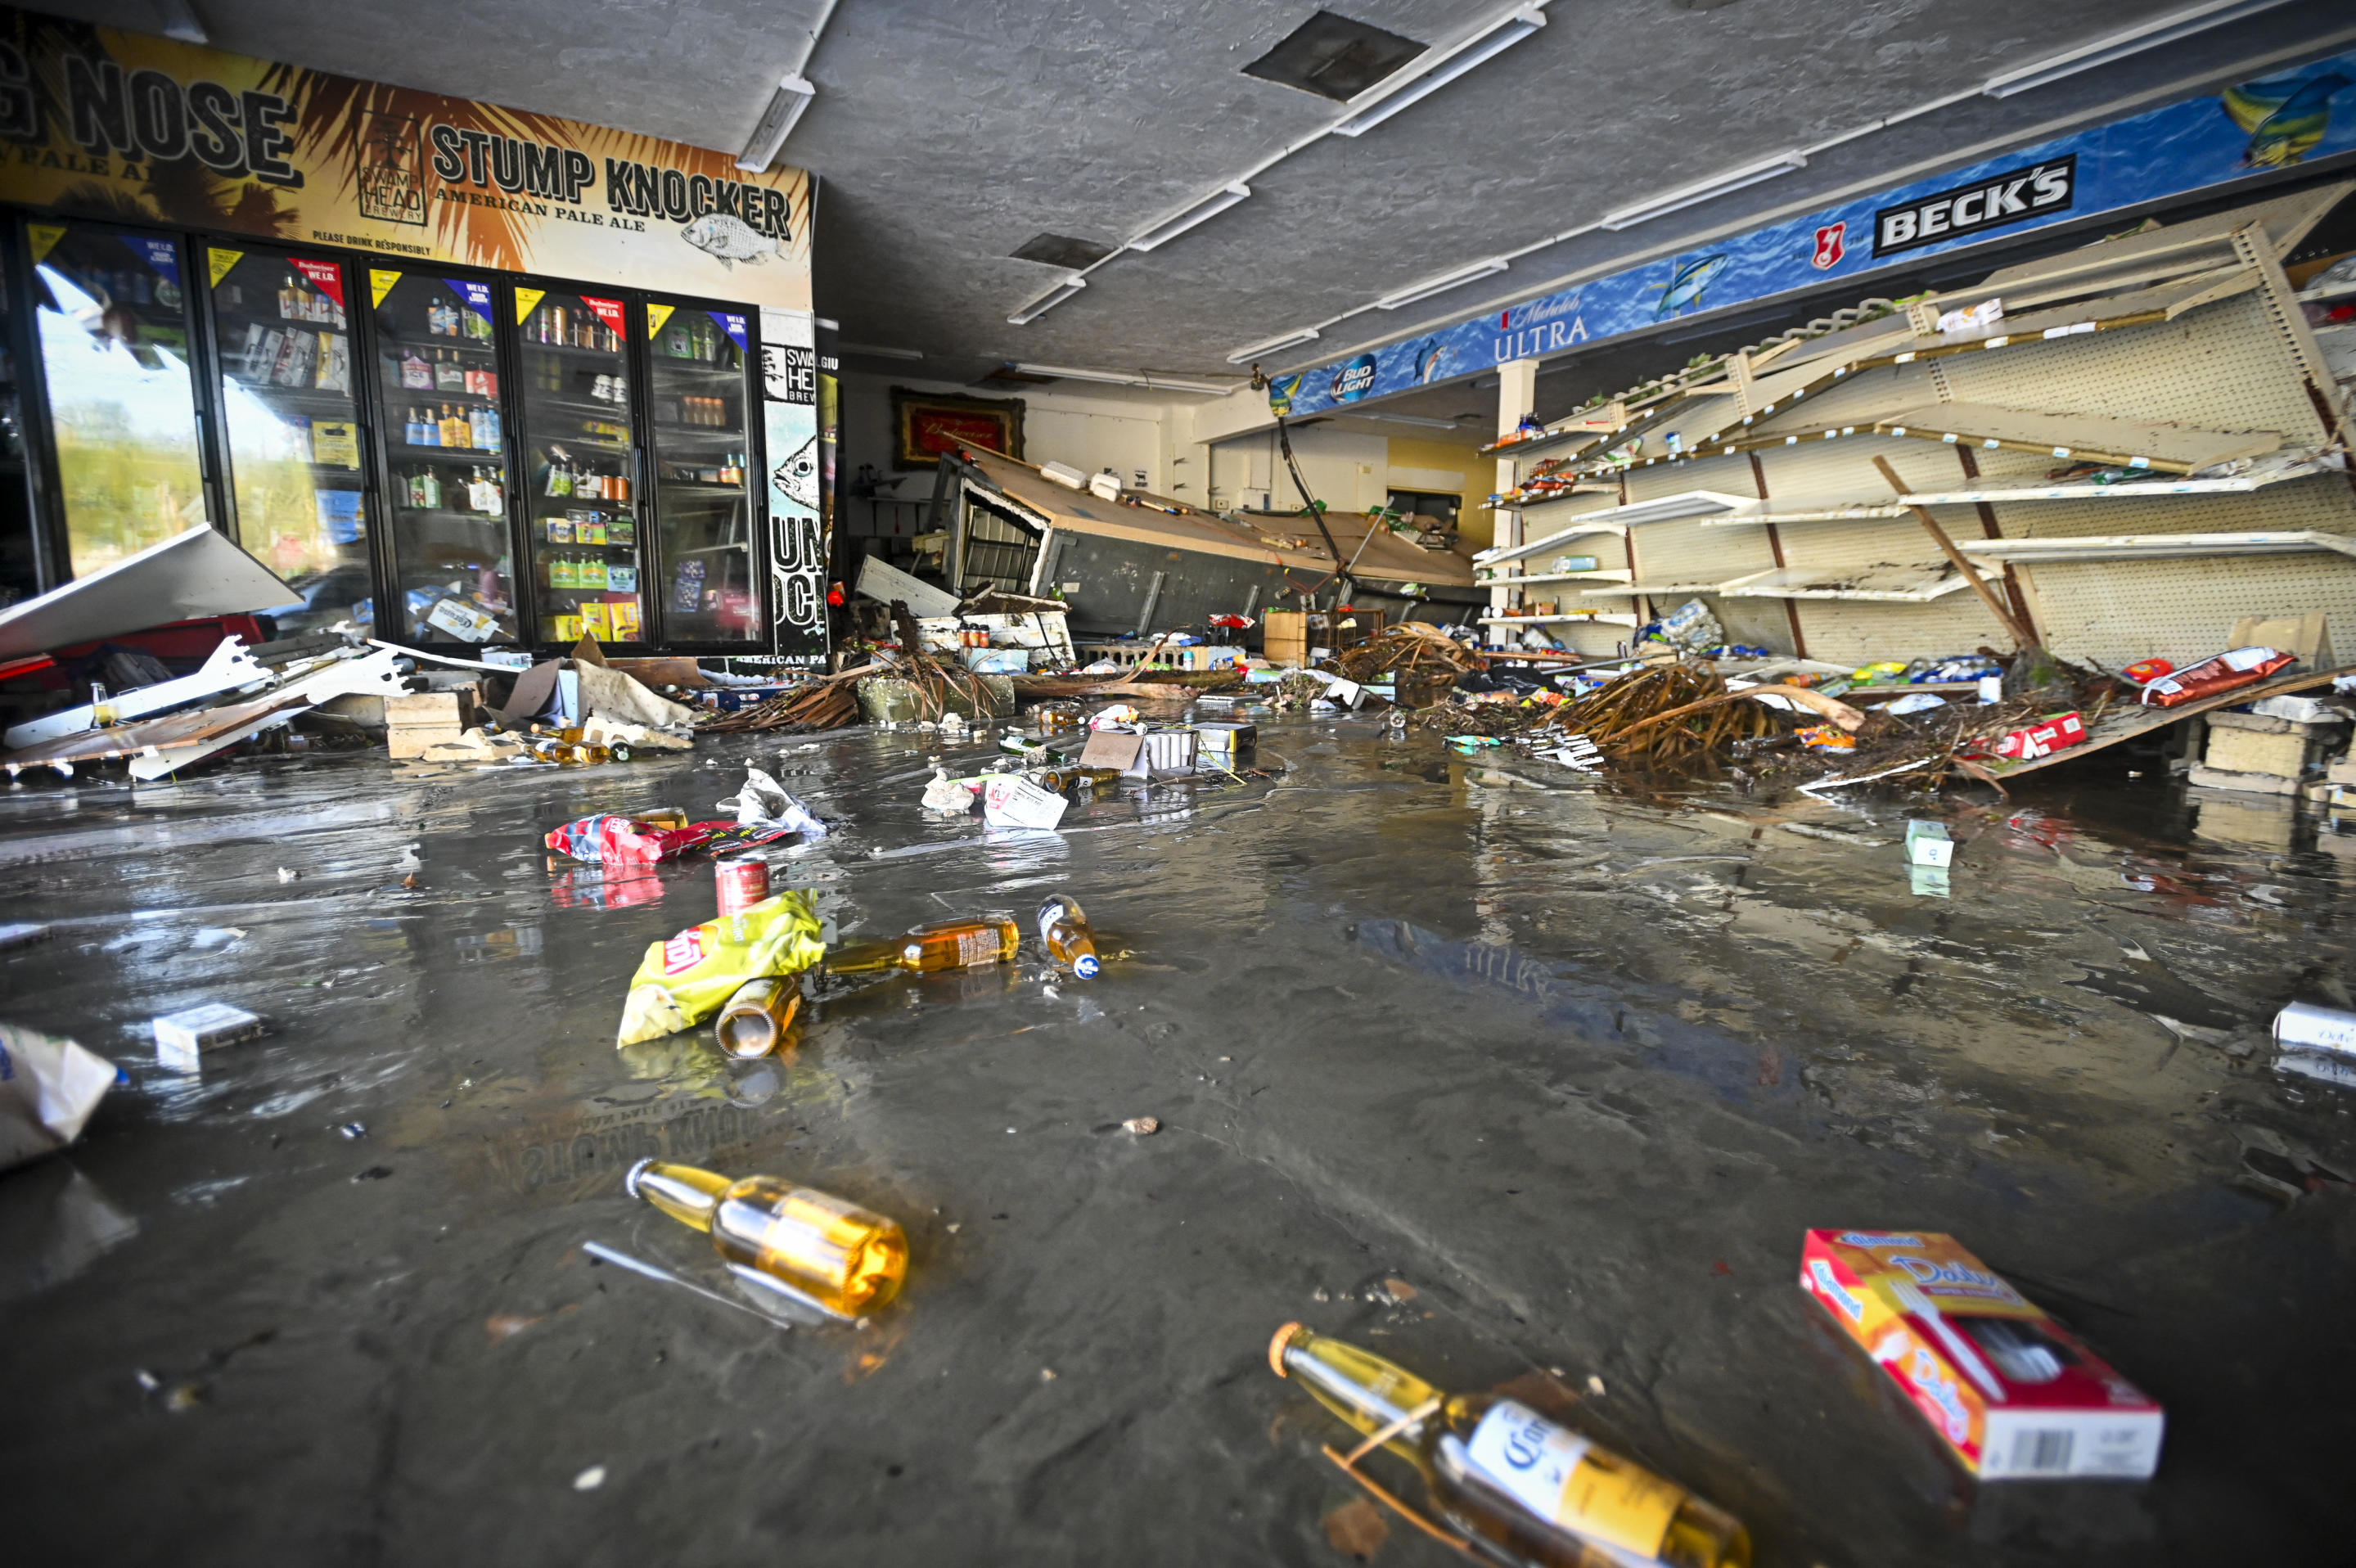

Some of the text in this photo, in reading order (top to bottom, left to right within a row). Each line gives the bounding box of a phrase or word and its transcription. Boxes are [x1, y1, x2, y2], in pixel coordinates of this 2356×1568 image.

[62, 53, 301, 187] NOSE
[361, 166, 420, 189] SWAMP
[430, 123, 791, 242] STUMP KNOCKER
[364, 186, 421, 210] HEAD
[1881, 165, 2069, 247] BECK'S
[366, 206, 422, 222] BREWERY
[435, 187, 646, 233] AMERICAN PALE ALE
[313, 230, 431, 256] PLEASE DRINK RESPONSIBLY
[308, 271, 322, 280] WE
[466, 283, 477, 292] WE
[597, 308, 607, 316] WE
[1511, 292, 1580, 329] Michelob
[1494, 314, 1591, 362] ULTRA
[1343, 365, 1372, 382] BUD
[1334, 376, 1375, 395] LIGHT
[737, 656, 805, 665] AMERICAN
[1851, 1234, 1921, 1247] diamond
[1814, 1264, 1863, 1320] diamond
